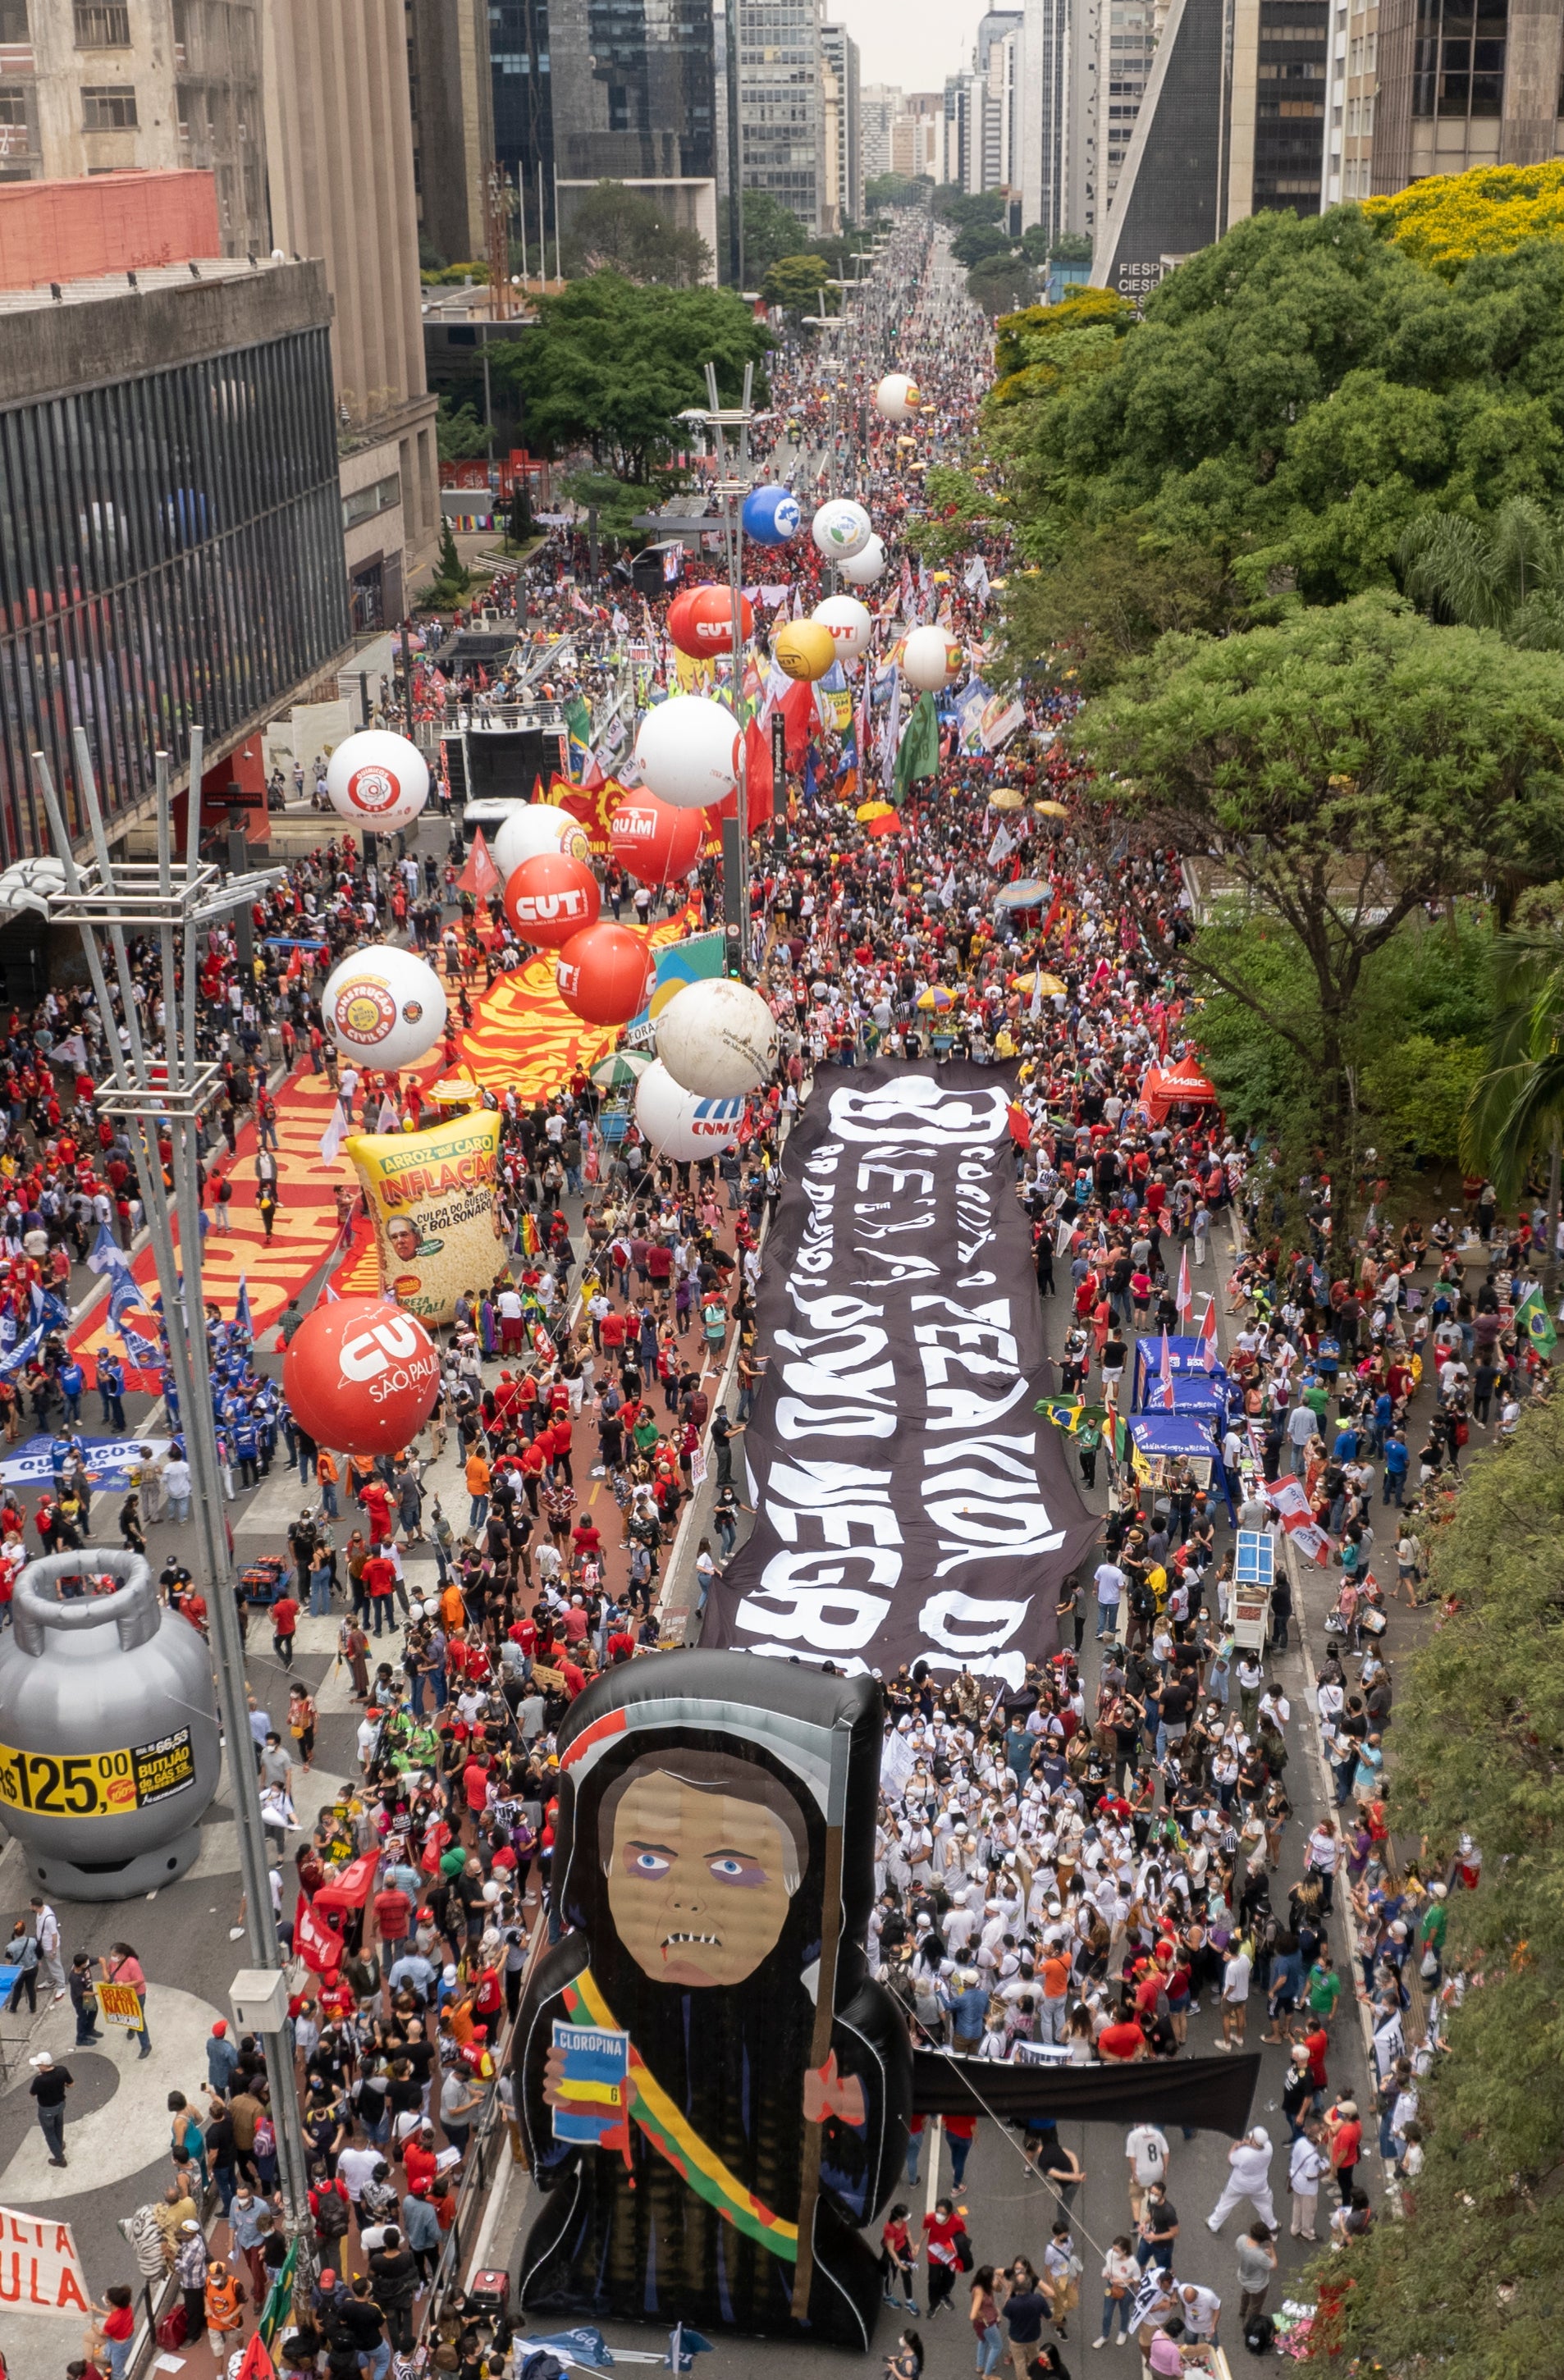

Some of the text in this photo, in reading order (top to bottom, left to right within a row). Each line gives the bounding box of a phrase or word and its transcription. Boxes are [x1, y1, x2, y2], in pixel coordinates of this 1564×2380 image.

[1119, 263, 1159, 275] FIESP
[1118, 279, 1159, 291] CIESP
[837, 522, 855, 530] UBES
[696, 621, 734, 637] CUT
[822, 624, 853, 638] UT
[516, 890, 581, 920] CUT
[337, 986, 392, 1023] CONSTRUÇÃO
[346, 1021, 389, 1043] CIVIL SP
[629, 1023, 655, 1041] FORA
[385, 1149, 436, 1173] ARROZ
[455, 1135, 492, 1154] CARO
[379, 1149, 497, 1207] INFLAÇÃO
[417, 1188, 492, 1223] CULPA DO GUEDES
[421, 1198, 492, 1233] E BOLSONARO
[339, 1313, 435, 1382] CUT
[911, 1295, 1029, 1430] PELA
[369, 1371, 409, 1403] SÃO
[729, 1281, 904, 1679] POVO NEGR
[922, 1432, 1067, 1578] VIDA
[1287, 1487, 1300, 1501] PDT
[1296, 1530, 1312, 1542] PDT
[156, 1729, 190, 1754] 66,53
[138, 1746, 190, 1779] BUTIJÃO
[139, 1777, 153, 1788] de
[154, 1769, 175, 1785] GÁS
[394, 1815, 409, 1823] FORA
[101, 1989, 133, 2004] BRASIL
[121, 2002, 140, 2017] UTI
[560, 2032, 622, 2056] CLOROPINA
[611, 2087, 618, 2102] G
[1148, 2143, 1158, 2162] 8
